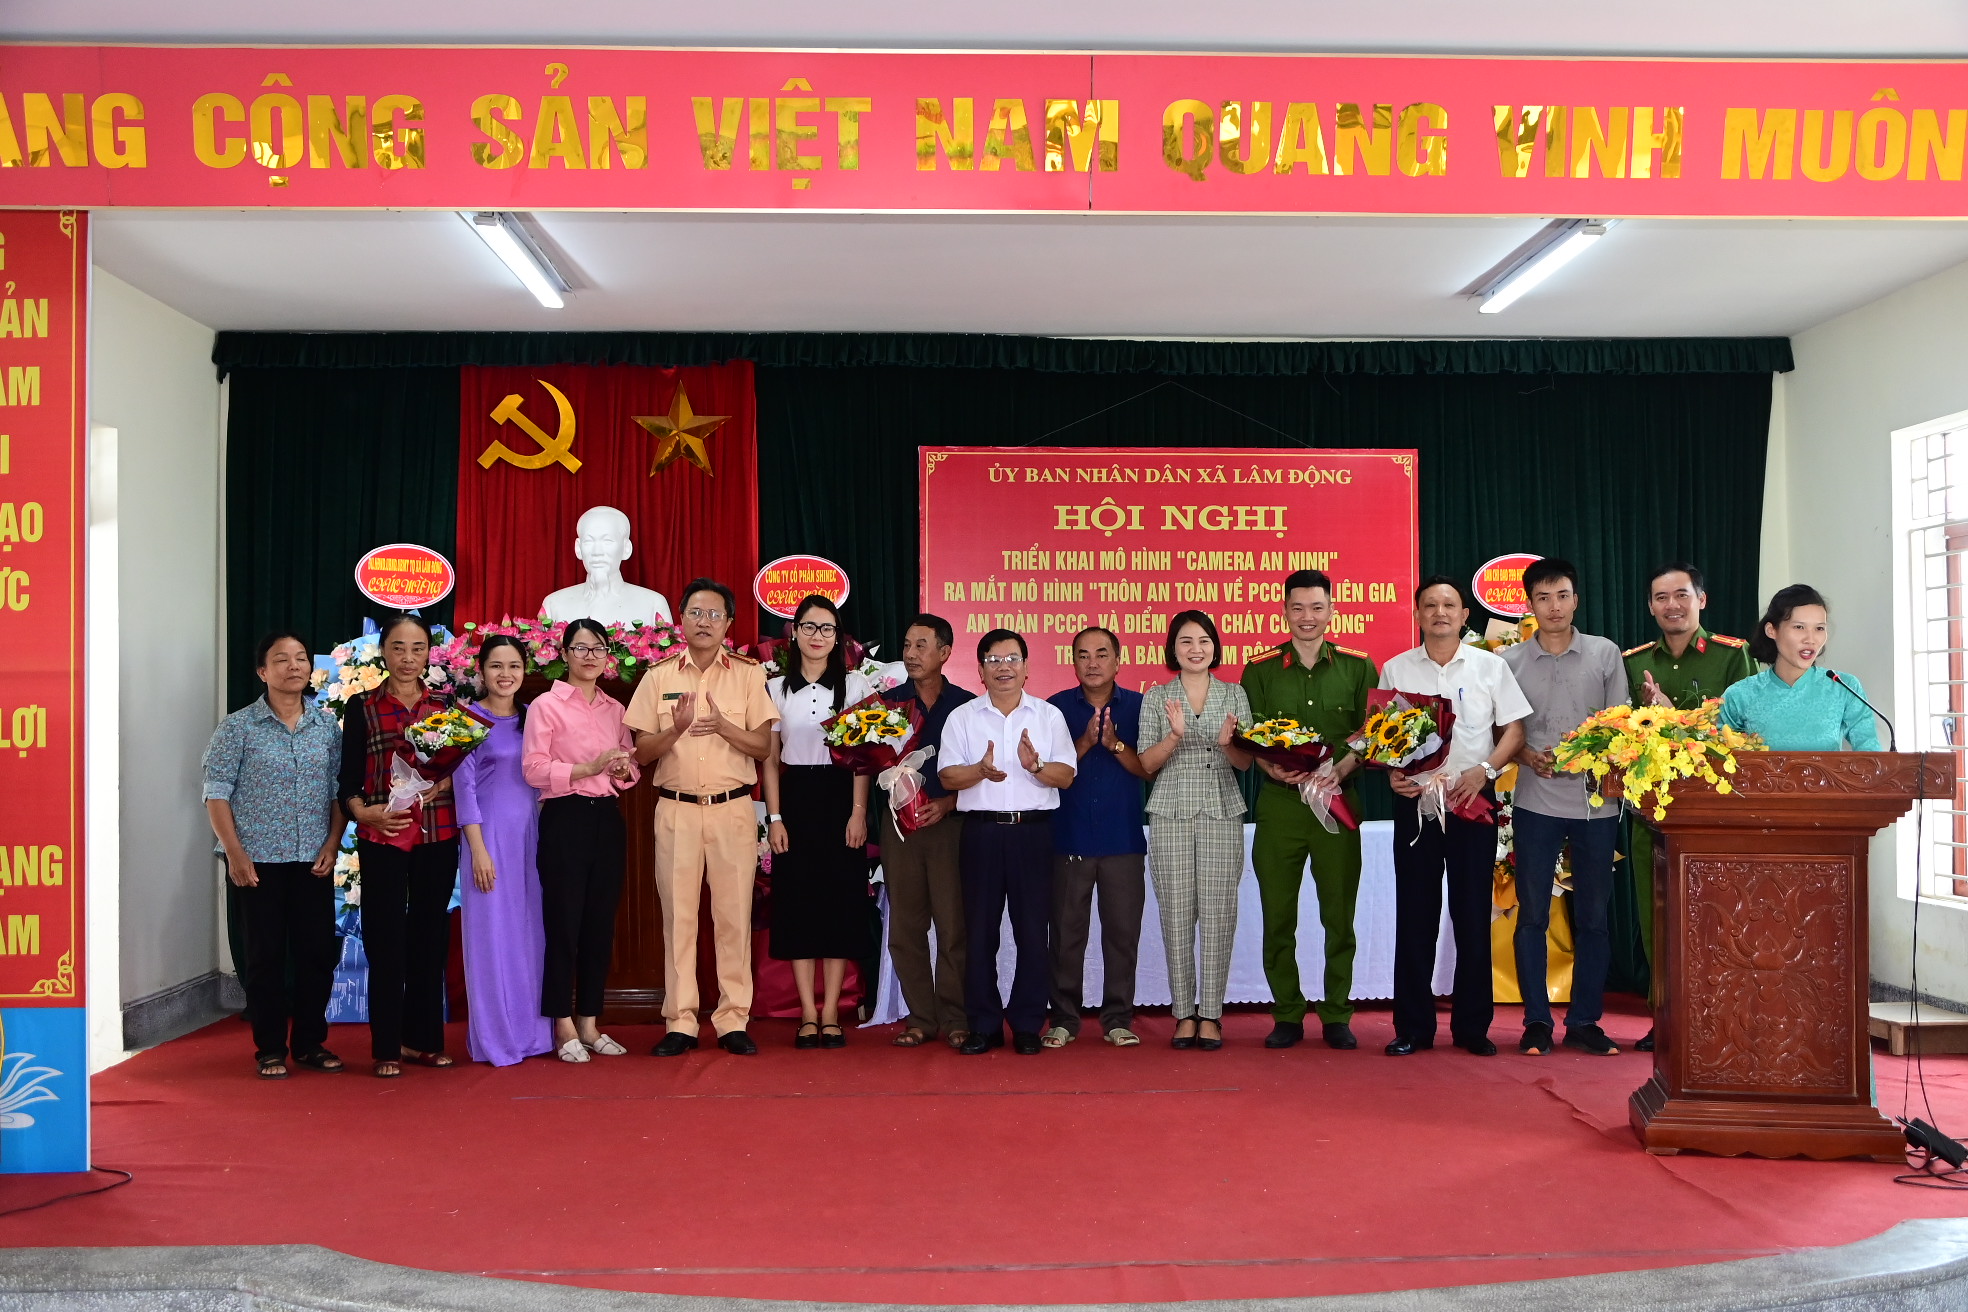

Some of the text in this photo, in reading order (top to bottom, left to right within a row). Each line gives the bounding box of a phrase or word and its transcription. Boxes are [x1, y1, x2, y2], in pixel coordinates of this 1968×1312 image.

[192, 73, 425, 187] CỘNG
[470, 63, 648, 170] SẢN
[691, 78, 872, 189] VIỆT
[916, 98, 1119, 172] NAM
[1162, 99, 1448, 182] QUANG
[1491, 105, 1684, 179] VINH
[1721, 88, 1968, 182] MUÔN
[988, 462, 1352, 488] ỦY BAN NHÂN DÂN XÃ LÂM ĐỘNG
[1053, 496, 1288, 538] HỘI NGHỊ
[1001, 543, 1338, 572] TRIỂN KHAI MÔ HÌNH "CAMERA AN NINH"
[943, 581, 966, 602] RA
[970, 575, 1007, 602] MẮT
[1011, 578, 1038, 602] MÔ
[1043, 578, 1083, 602] HÌNH
[1089, 578, 1142, 602] "THÔN
[1146, 582, 1170, 602] AN
[1175, 578, 1219, 602] TOÀN
[1223, 576, 1243, 602] VỀ
[1330, 579, 1363, 603] LIÊN
[1368, 583, 1397, 603] GIA
[966, 613, 990, 633] AN
[994, 610, 1038, 634] TOÀN
[1043, 613, 1088, 634] PCCC
[1098, 610, 1120, 634] VÀ
[1124, 606, 1167, 634] ĐIỂM
[1221, 610, 1265, 634] CHÁY
